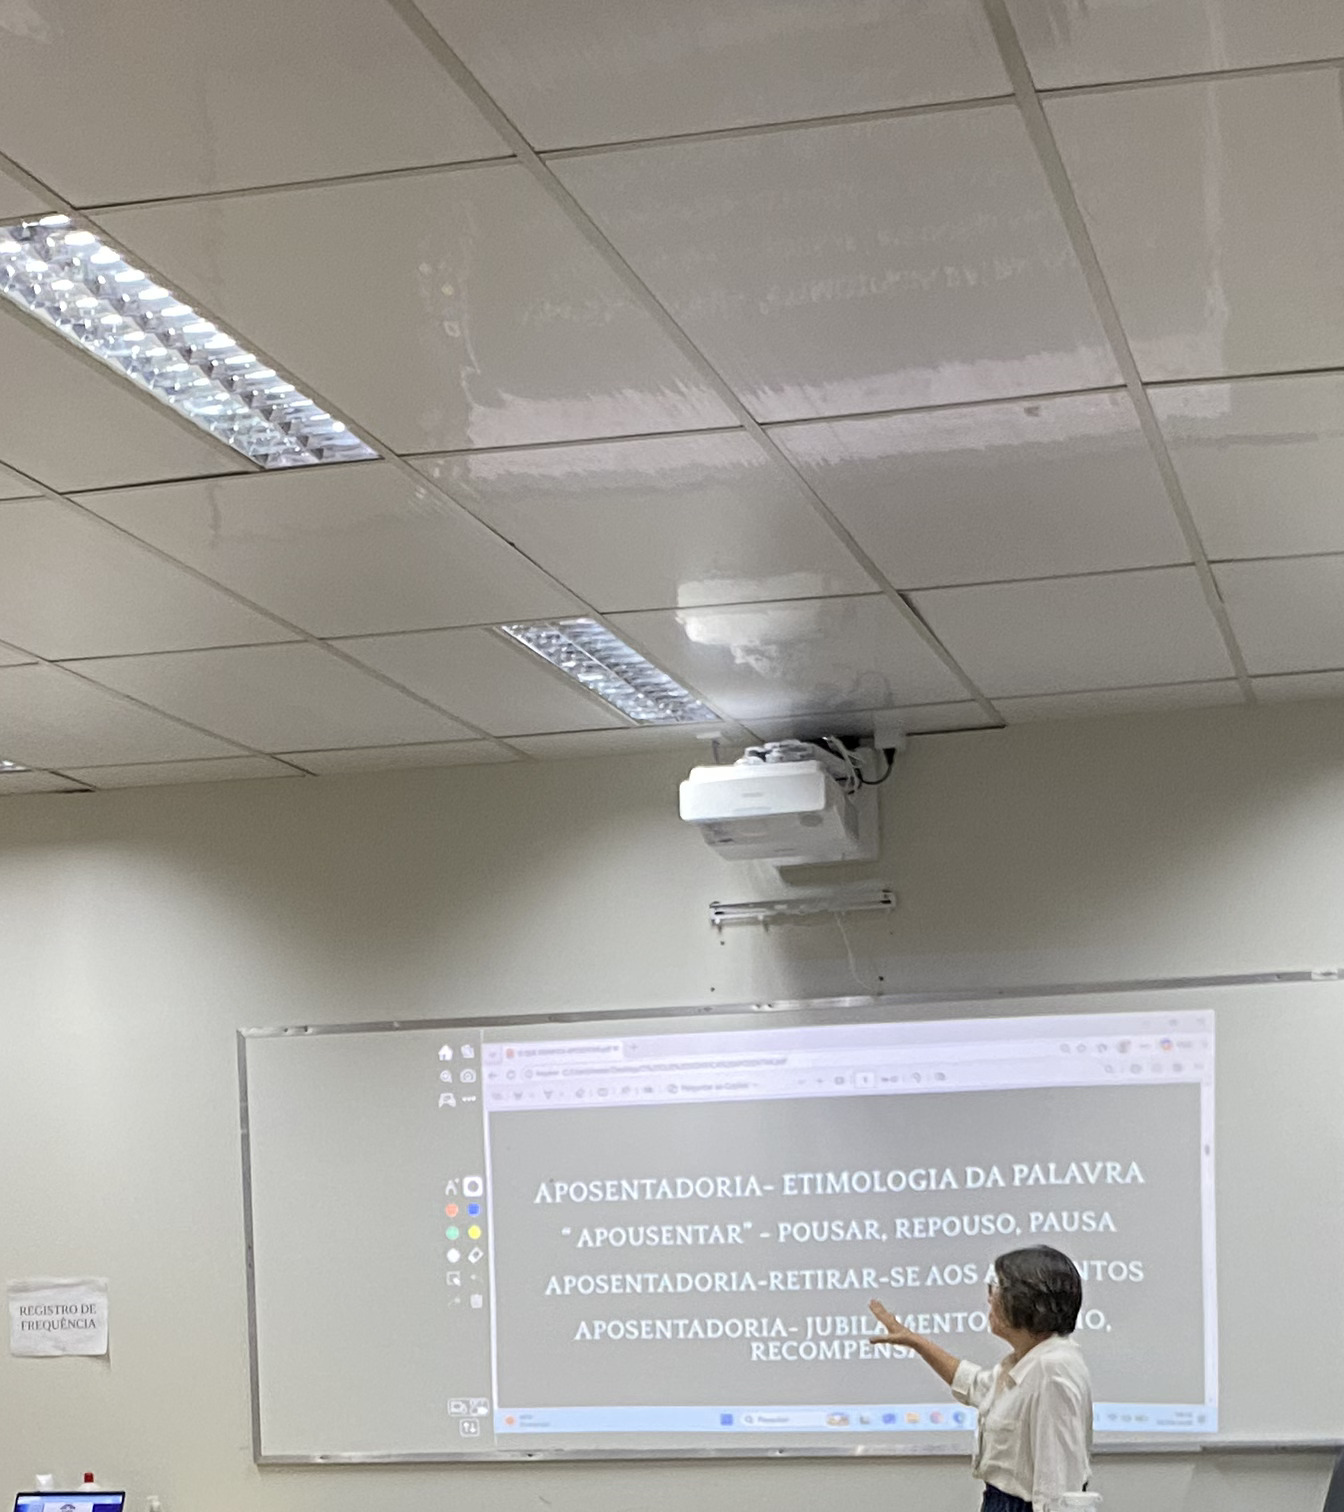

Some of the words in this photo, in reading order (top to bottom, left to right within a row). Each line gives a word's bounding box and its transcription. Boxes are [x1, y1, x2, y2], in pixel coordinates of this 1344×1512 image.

[533, 1174, 775, 1204] APOSENTADORIA-
[782, 1166, 959, 1196] ETIMOLOGIA
[964, 1165, 1006, 1190] DA
[1012, 1160, 1145, 1187] PALAVRA
[777, 1218, 888, 1244] POUSAR,
[894, 1212, 1022, 1239] REPOUSO,
[1029, 1210, 1118, 1234] PAUSA
[924, 1263, 979, 1287] AOS
[19, 1304, 78, 1316] REGISTRO
[81, 1303, 97, 1315] DE
[21, 1317, 96, 1331] FREQUÊNCIA
[573, 1316, 799, 1341] APOSENTADORIA-
[750, 1339, 918, 1361] RECOMPENS
